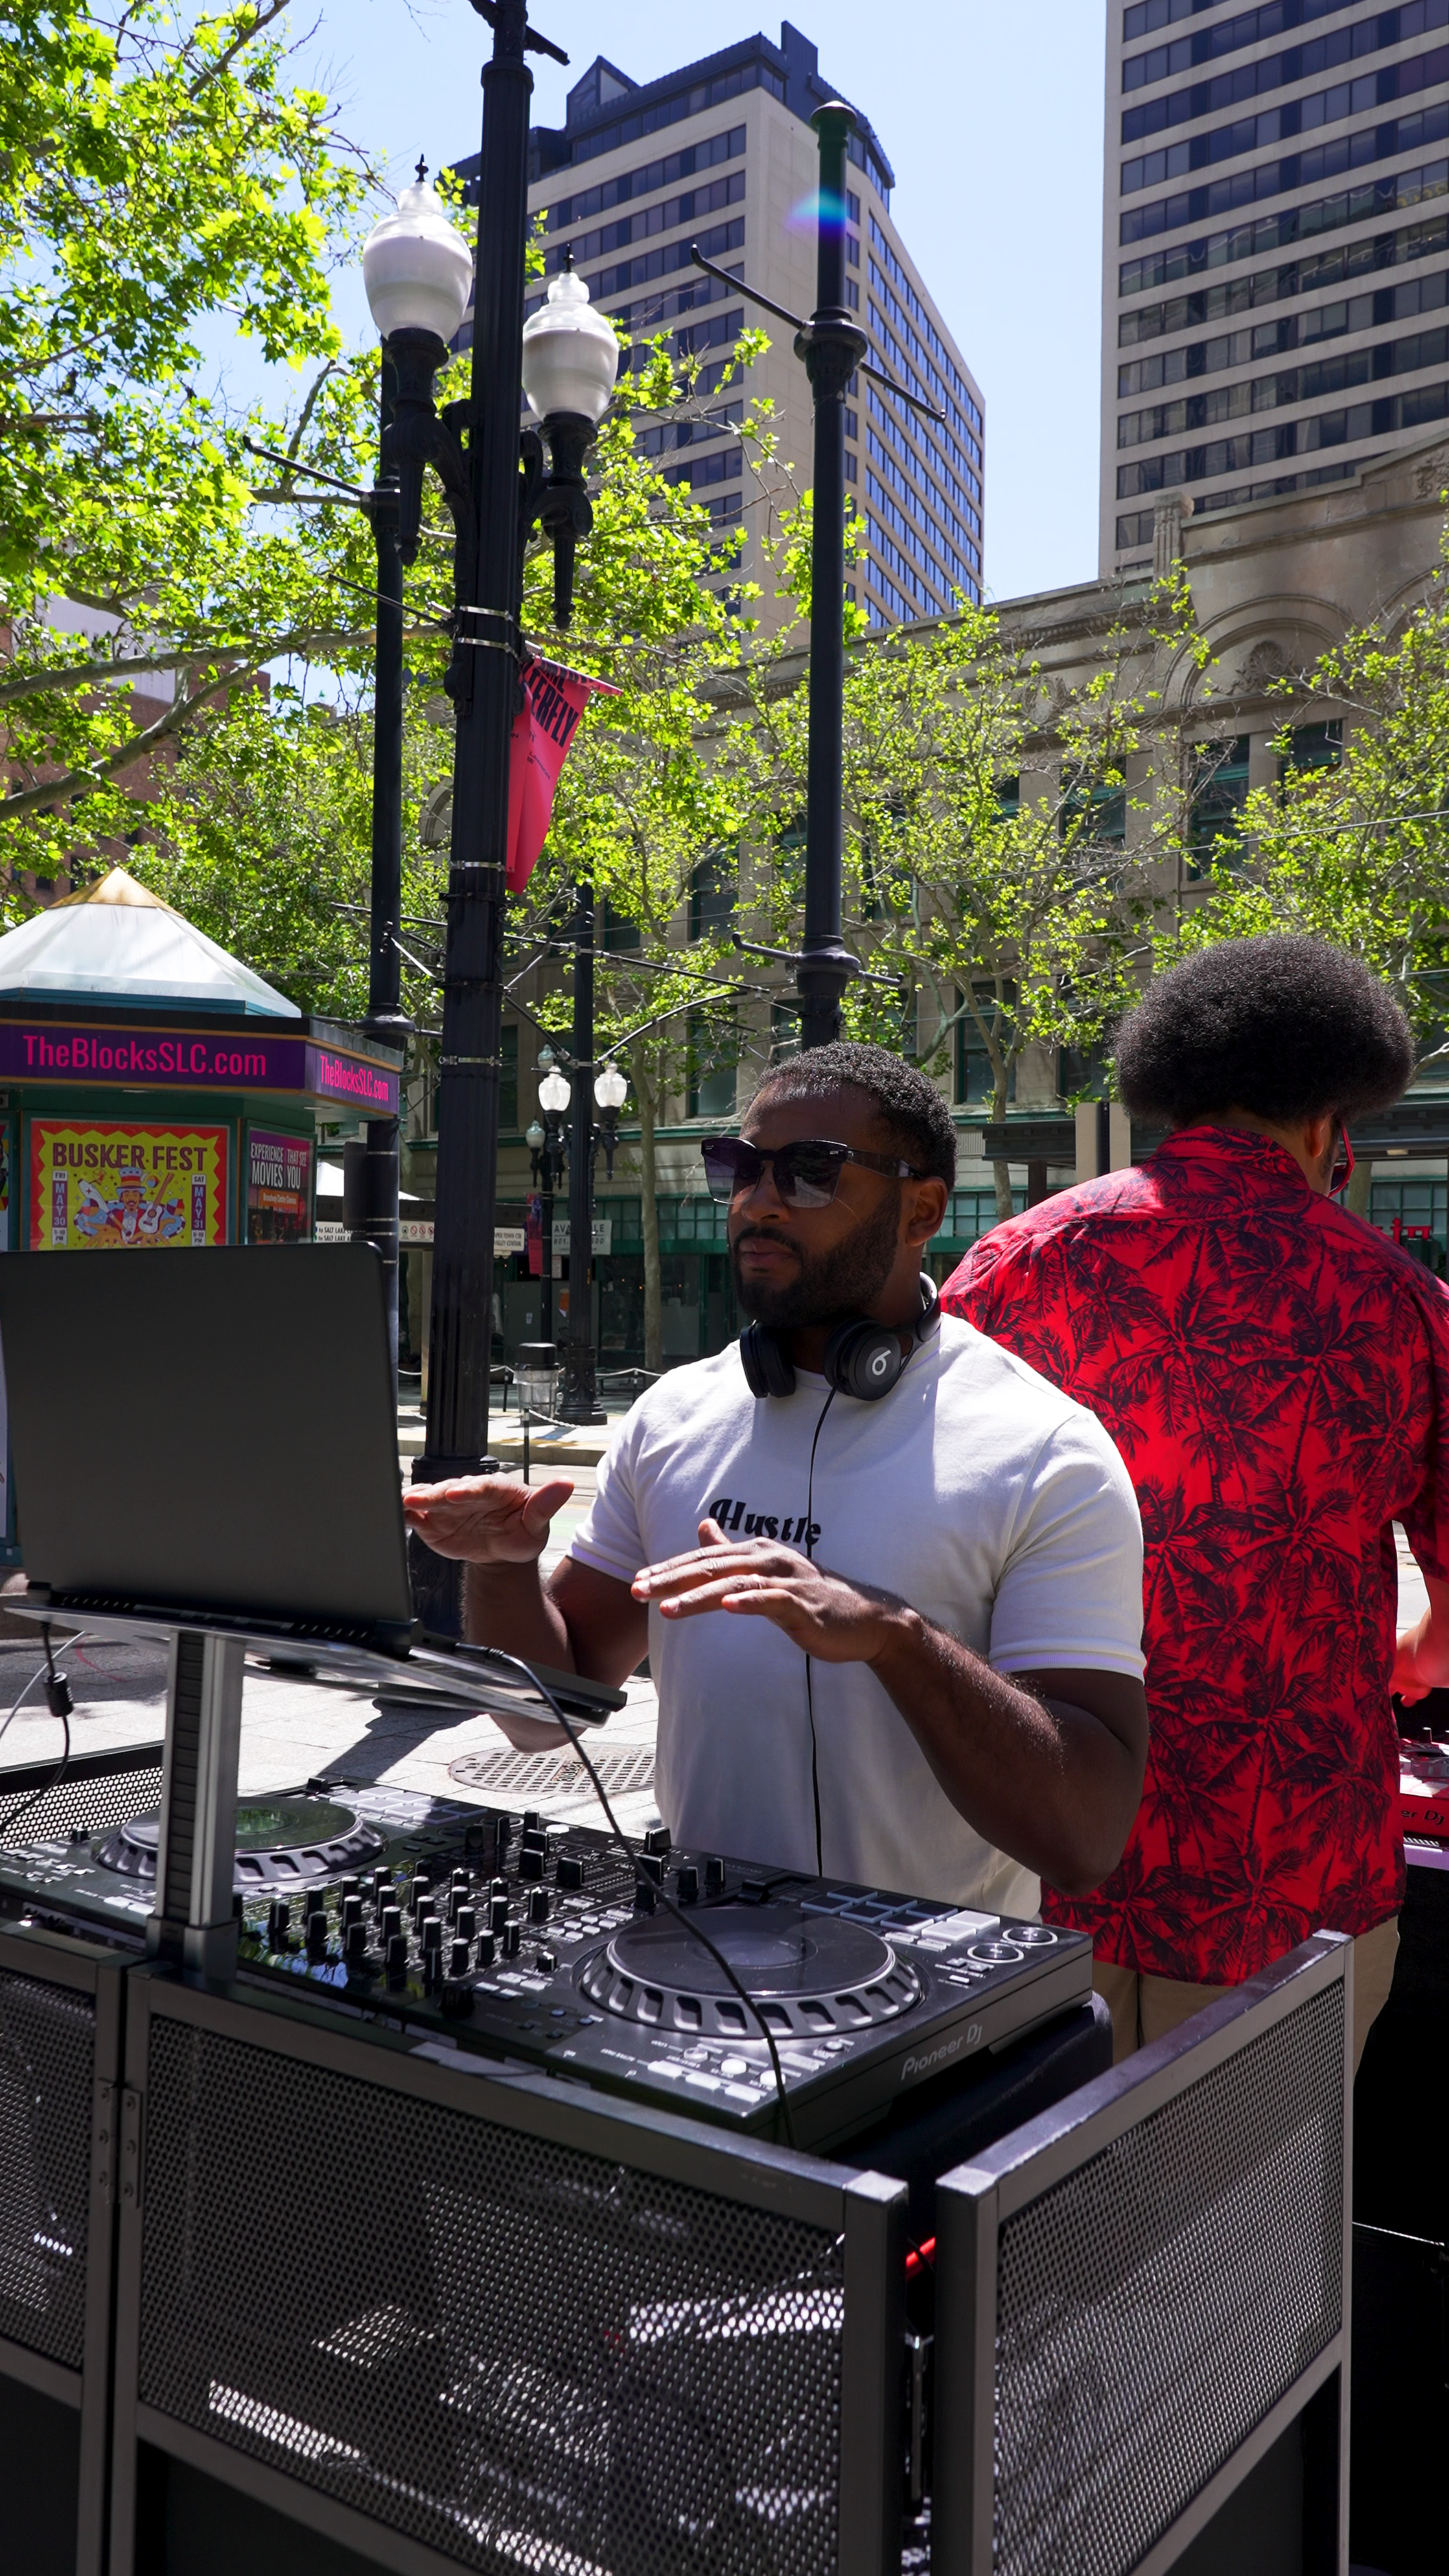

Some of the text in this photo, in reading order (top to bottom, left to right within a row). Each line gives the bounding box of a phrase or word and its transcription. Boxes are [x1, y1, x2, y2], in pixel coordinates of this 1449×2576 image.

[524, 664, 579, 748] TERFLY
[23, 1035, 266, 1077] TheBlocksSLC.com
[320, 1055, 389, 1102] TheBlocksSLC.com
[52, 1142, 207, 1171] BUSKER FEST
[251, 1142, 283, 1164] EXPERIENCE
[287, 1149, 307, 1166] THAT SEE
[252, 1160, 283, 1188] MOVIES
[287, 1165, 301, 1189] YOU
[54, 1217, 66, 1227] 30
[194, 1219, 204, 1228] 31
[709, 1499, 821, 1545] Hustle
[901, 2036, 964, 2081] Pioneer
